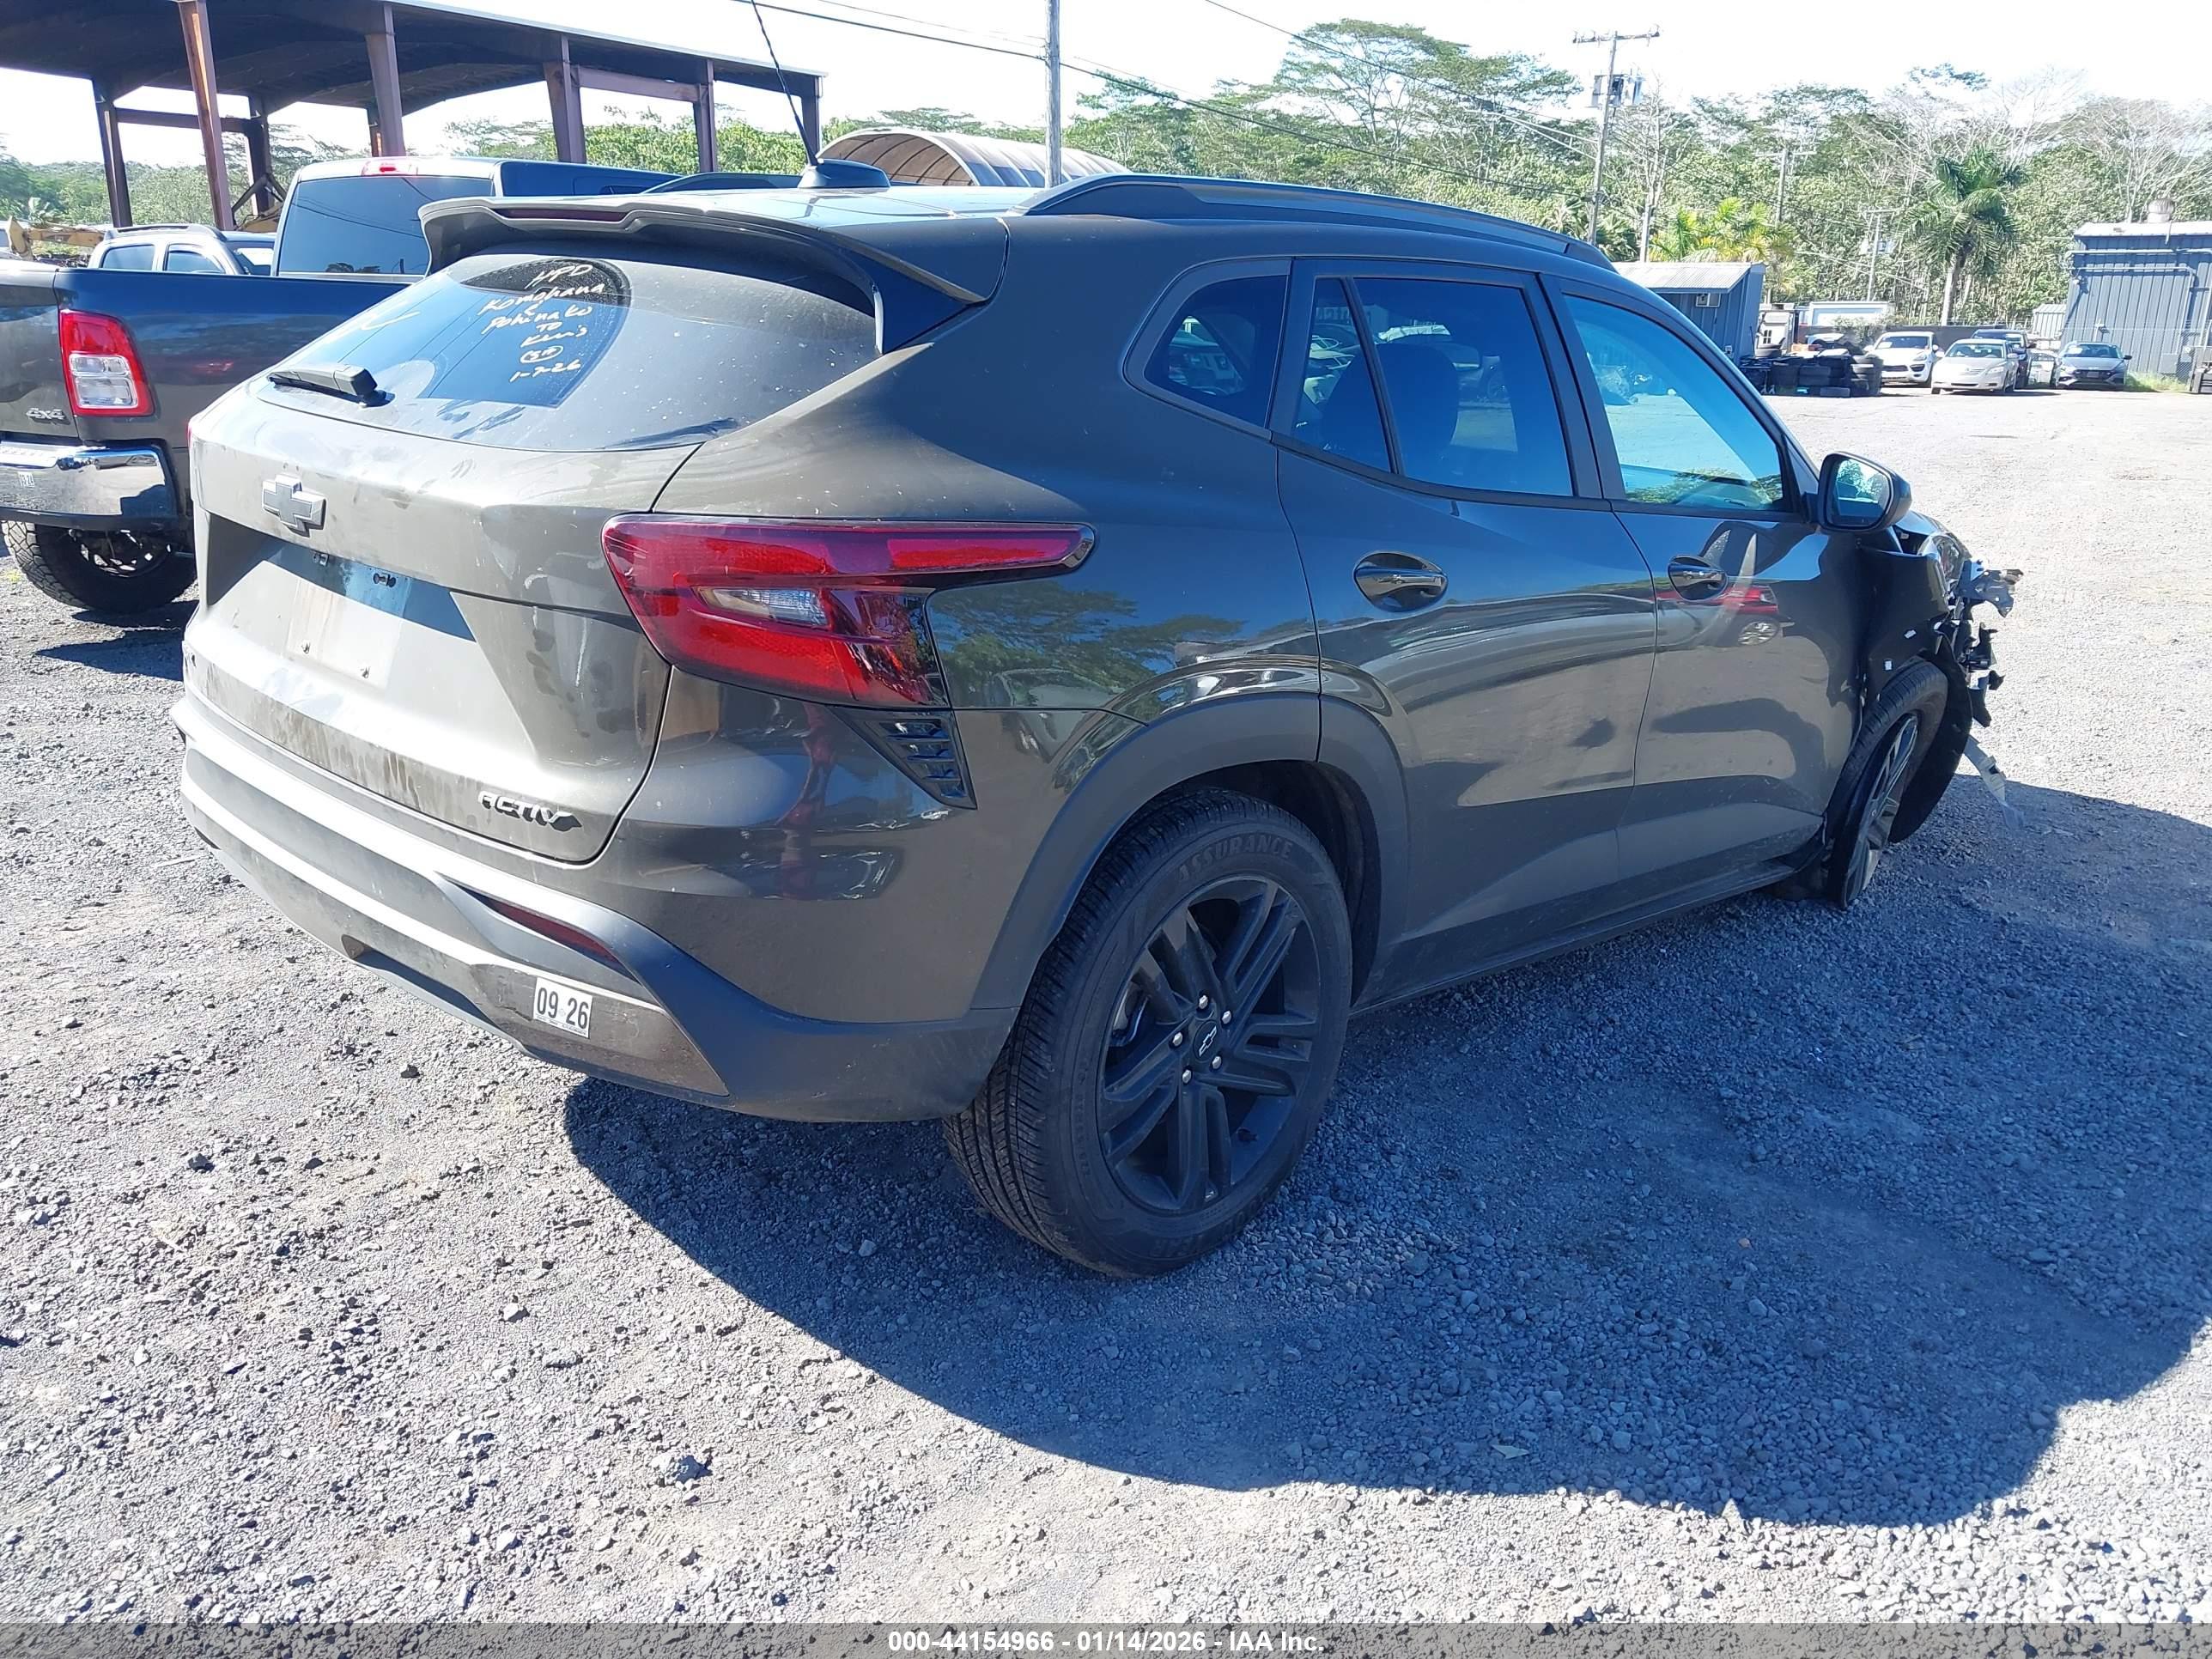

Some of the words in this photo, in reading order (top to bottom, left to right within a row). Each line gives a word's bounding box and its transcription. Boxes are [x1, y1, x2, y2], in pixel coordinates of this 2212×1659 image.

[477, 791, 582, 831] ACTIV
[537, 987, 560, 1019] 09
[565, 997, 589, 1030] 26
